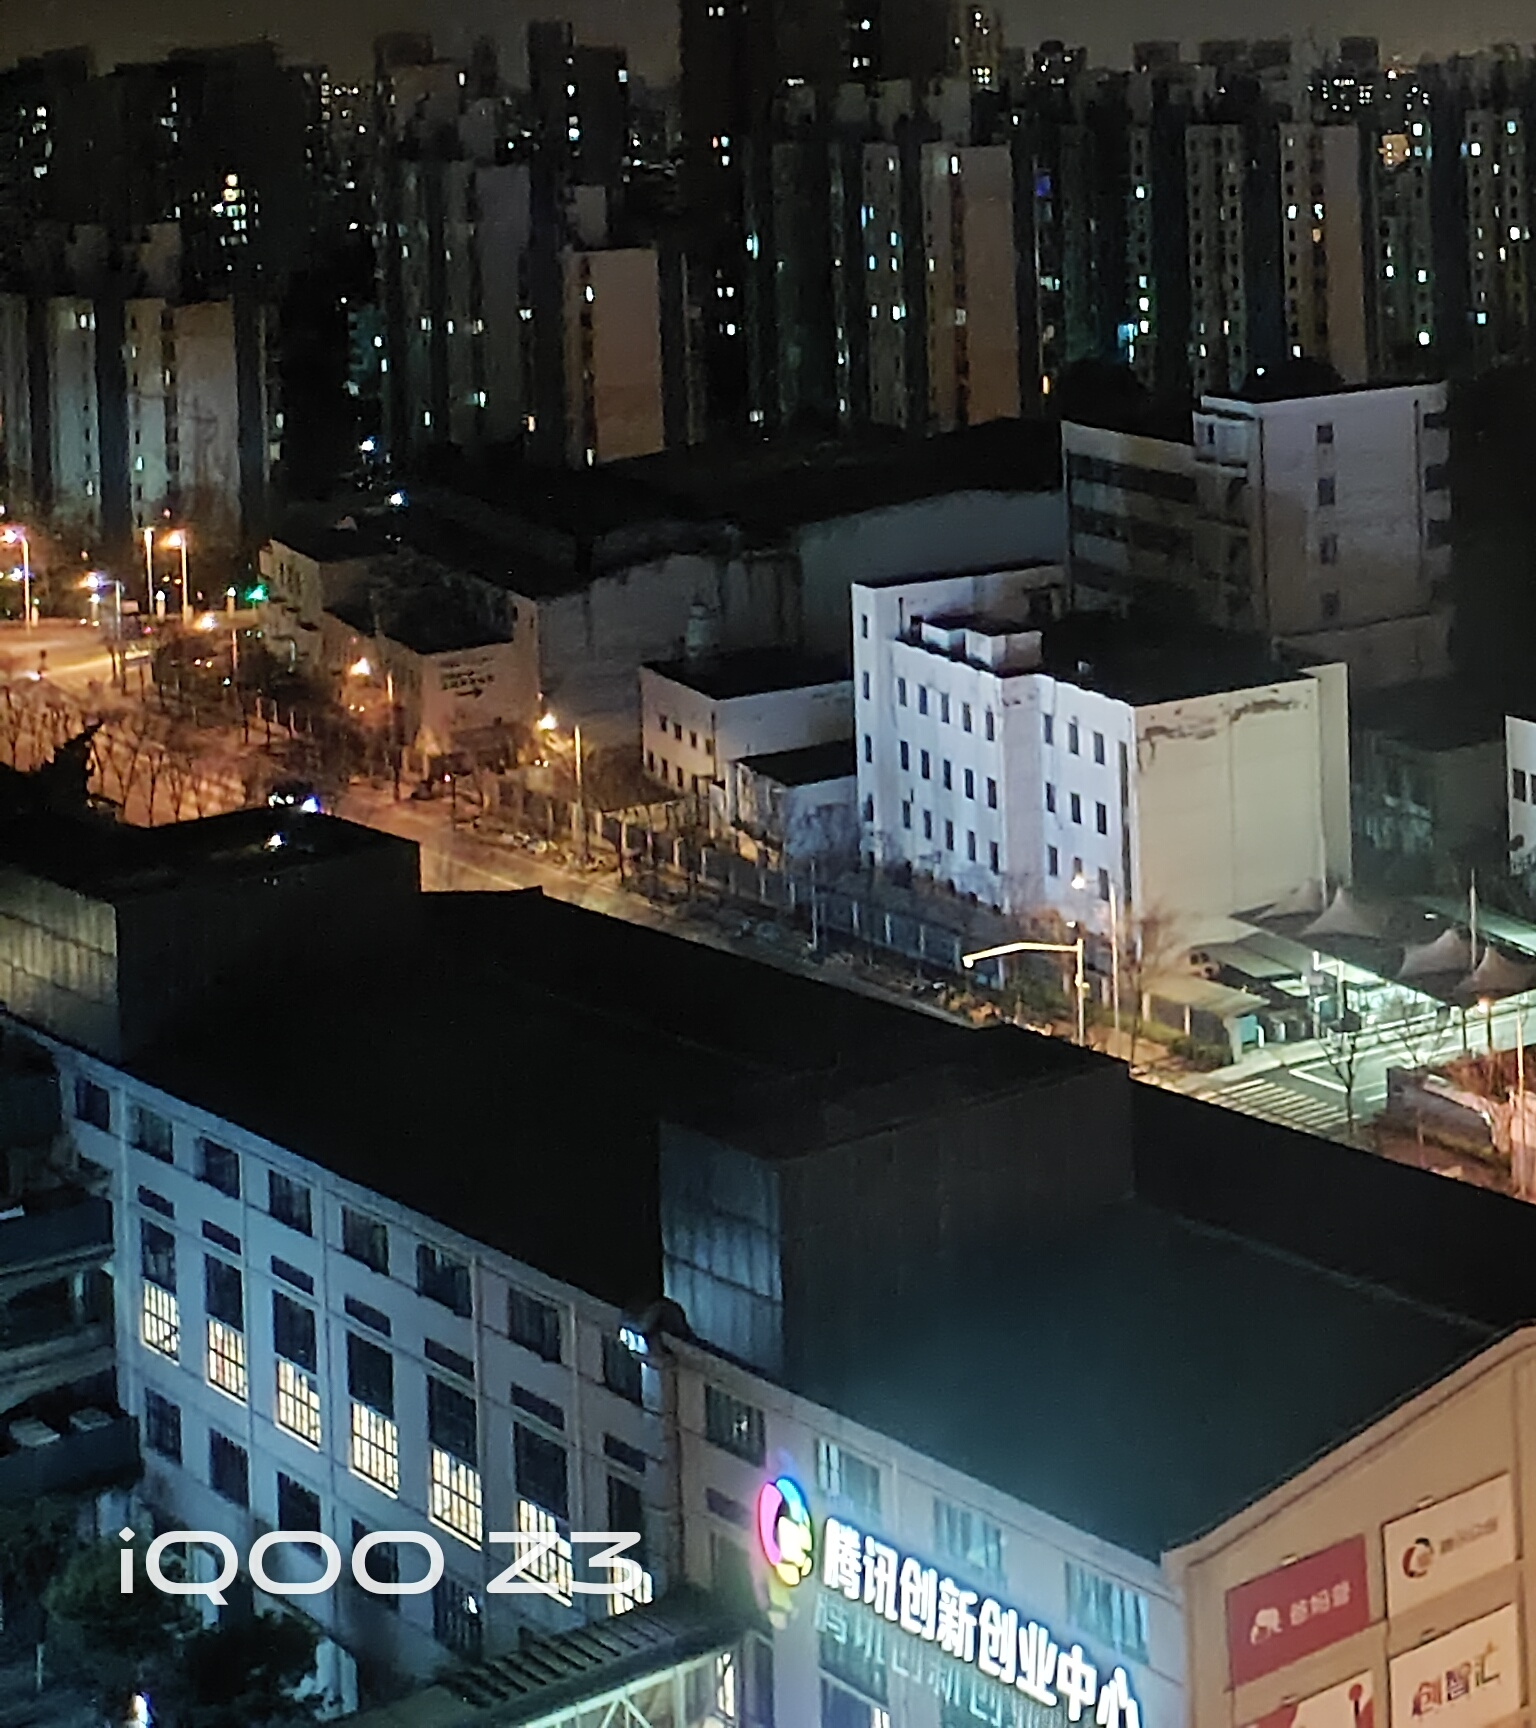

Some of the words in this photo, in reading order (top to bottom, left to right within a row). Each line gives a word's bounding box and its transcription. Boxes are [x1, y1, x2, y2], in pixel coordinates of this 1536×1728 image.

[823, 1517, 1142, 1728] 腾讯创新创业中心
